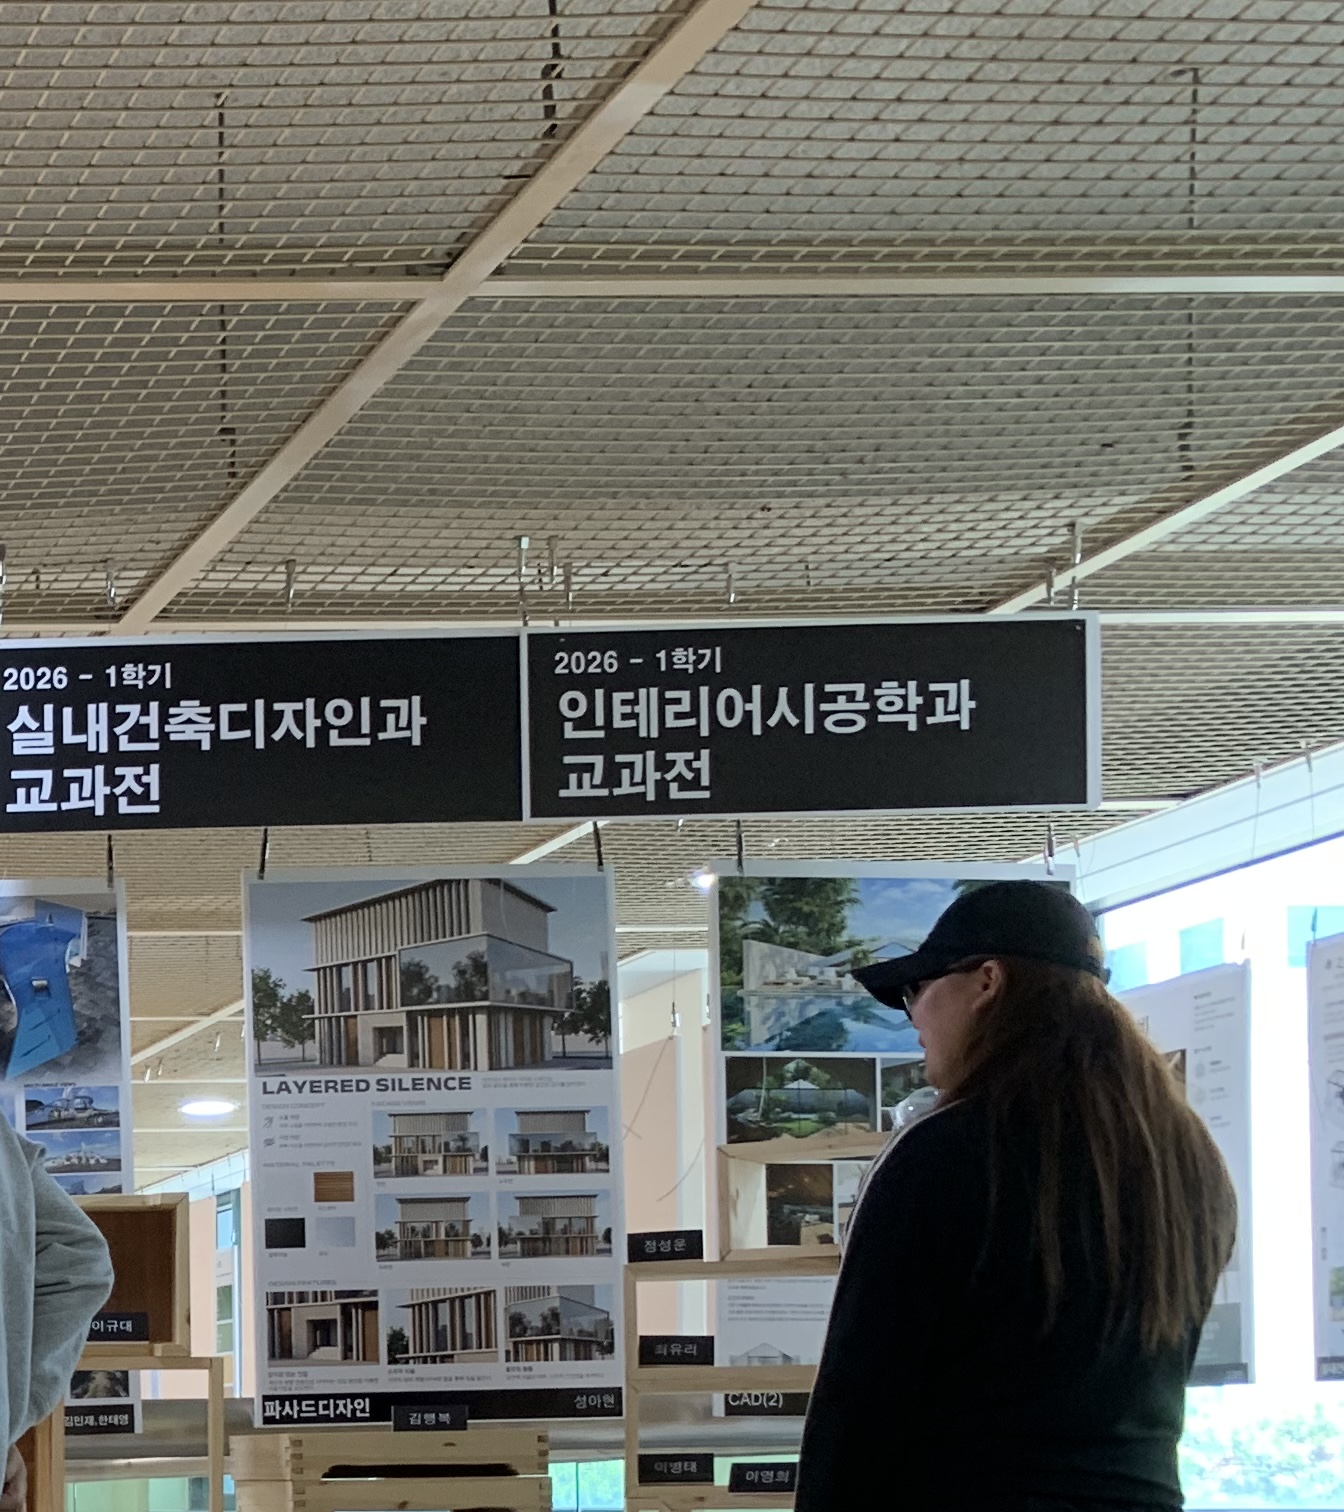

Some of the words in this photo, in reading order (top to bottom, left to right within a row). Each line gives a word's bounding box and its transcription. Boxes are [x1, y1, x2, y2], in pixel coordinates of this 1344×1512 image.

[554, 650, 619, 675] 2026
[655, 646, 722, 674] 1학기
[3, 666, 68, 691] 2026
[105, 662, 172, 690] 1학기
[559, 678, 977, 739] 인테리어시공학과
[6, 695, 428, 756] 실내건축디자인과
[5, 763, 161, 816] 교과전
[558, 748, 711, 802] 교과전
[262, 1078, 371, 1095] LAYERED
[375, 1076, 472, 1093] SILENCE
[92, 1320, 133, 1333] 이규대
[263, 1397, 371, 1420] 파사드디자인
[727, 1393, 784, 1409] CAD(2)
